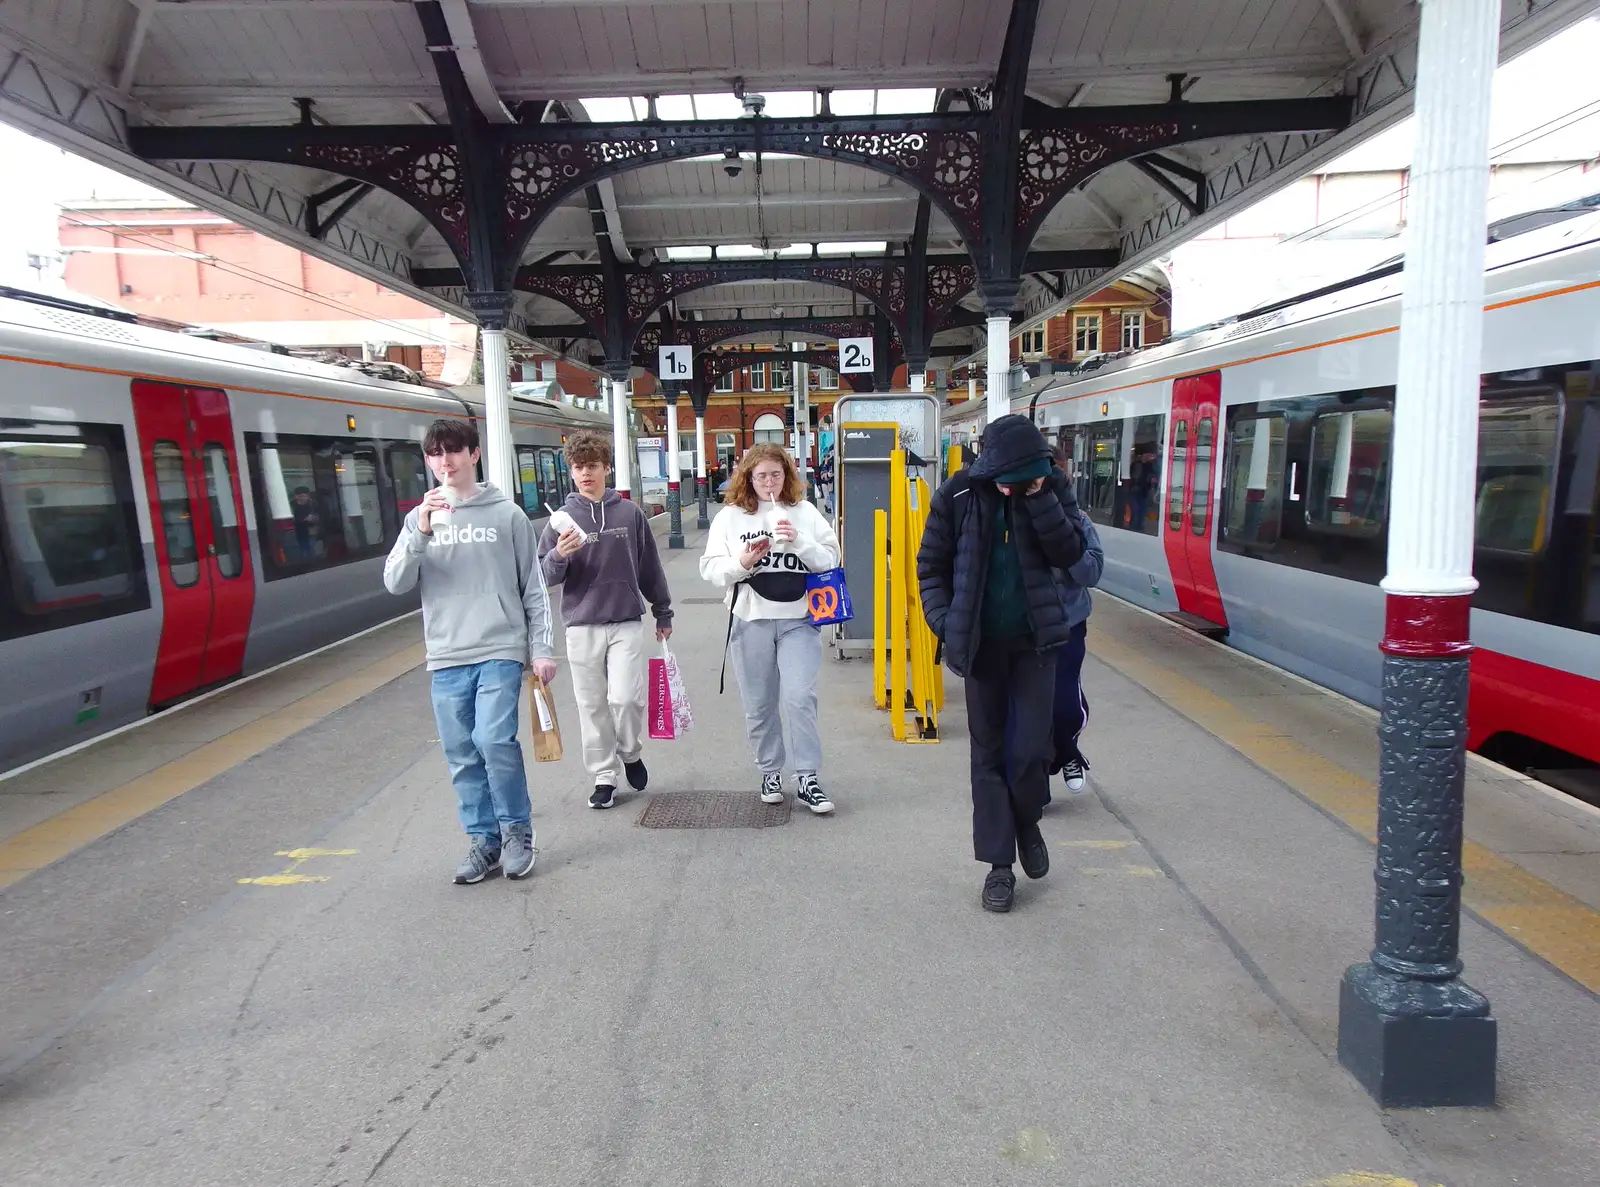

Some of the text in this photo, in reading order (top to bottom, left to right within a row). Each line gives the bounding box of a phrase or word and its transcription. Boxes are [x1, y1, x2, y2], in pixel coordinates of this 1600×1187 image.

[665, 351, 687, 373] 1b
[845, 344, 871, 367] 2b
[428, 523, 498, 546] adidas
[657, 664, 666, 731] WATERSTONES
